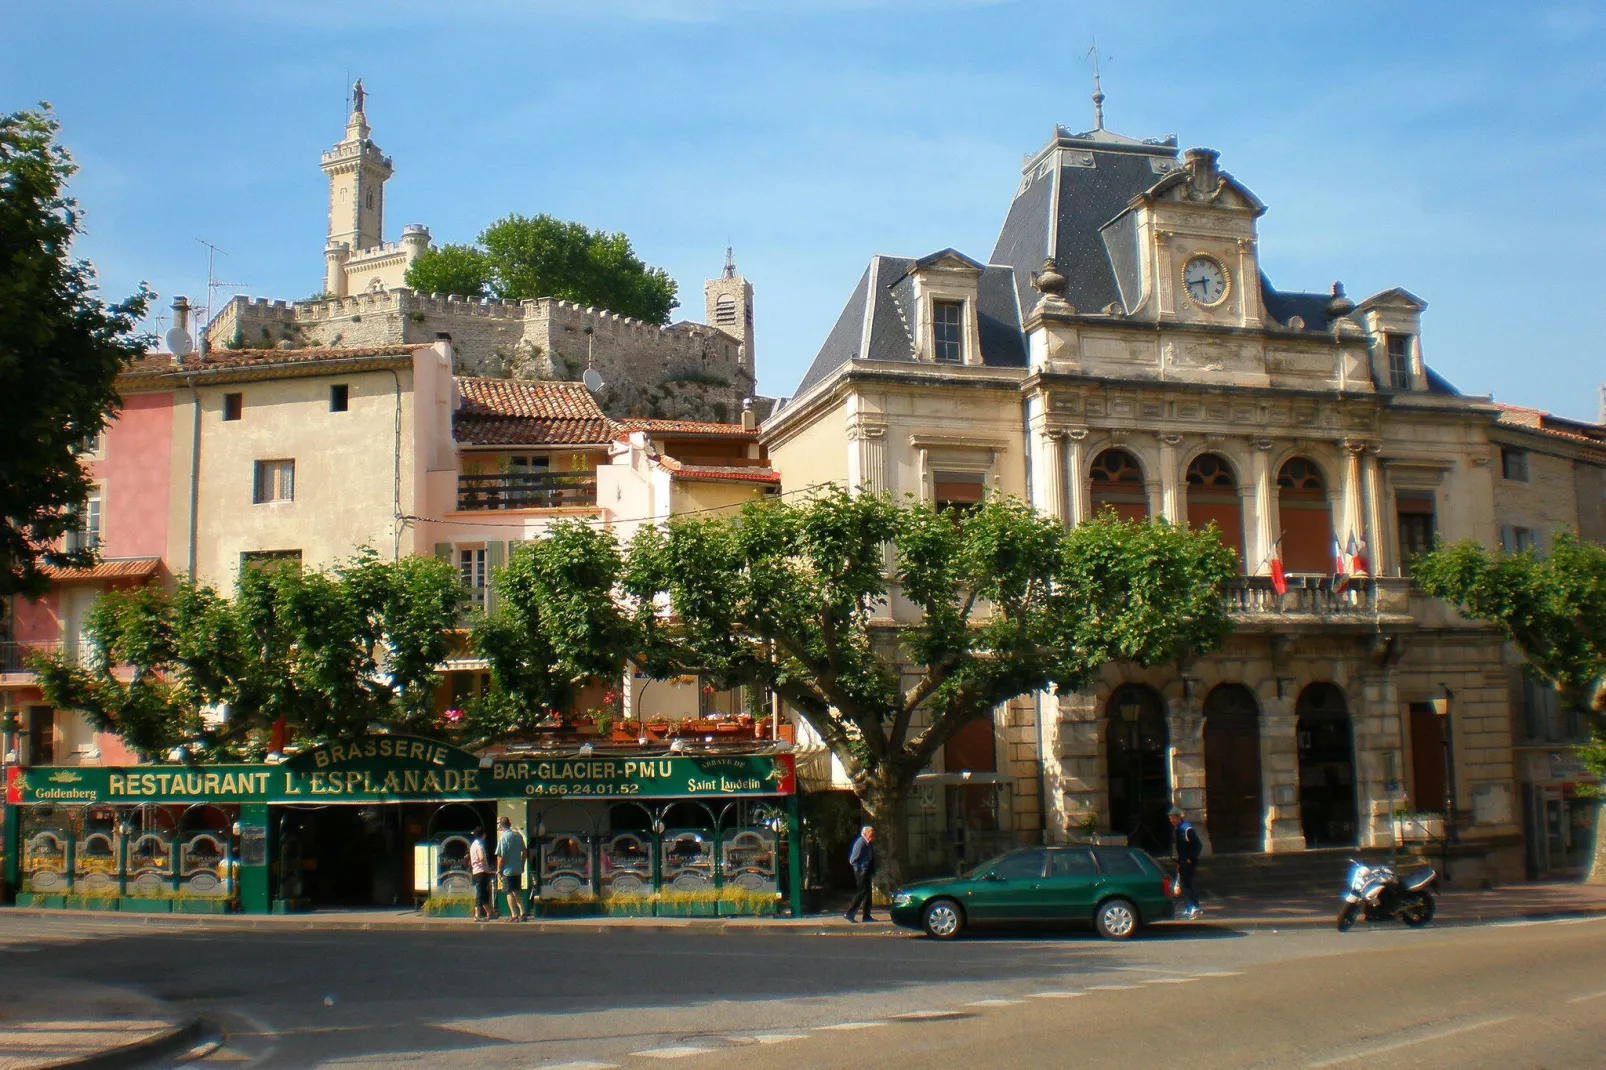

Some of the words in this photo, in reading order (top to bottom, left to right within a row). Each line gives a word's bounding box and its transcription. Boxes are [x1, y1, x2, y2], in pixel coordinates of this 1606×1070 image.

[314, 739, 449, 768] BRASSERIE
[493, 760, 672, 780] BAR-GLACIER-PMU
[702, 759, 732, 769] ABBAYE
[734, 760, 746, 769] DE
[109, 773, 270, 795] RESTAURANT
[284, 769, 481, 795] L'ESPLANADE
[525, 784, 639, 795] 04.66.24.01.52
[687, 778, 717, 792] Saint
[720, 776, 761, 792] Landelin
[35, 788, 97, 800] Goldenberg
